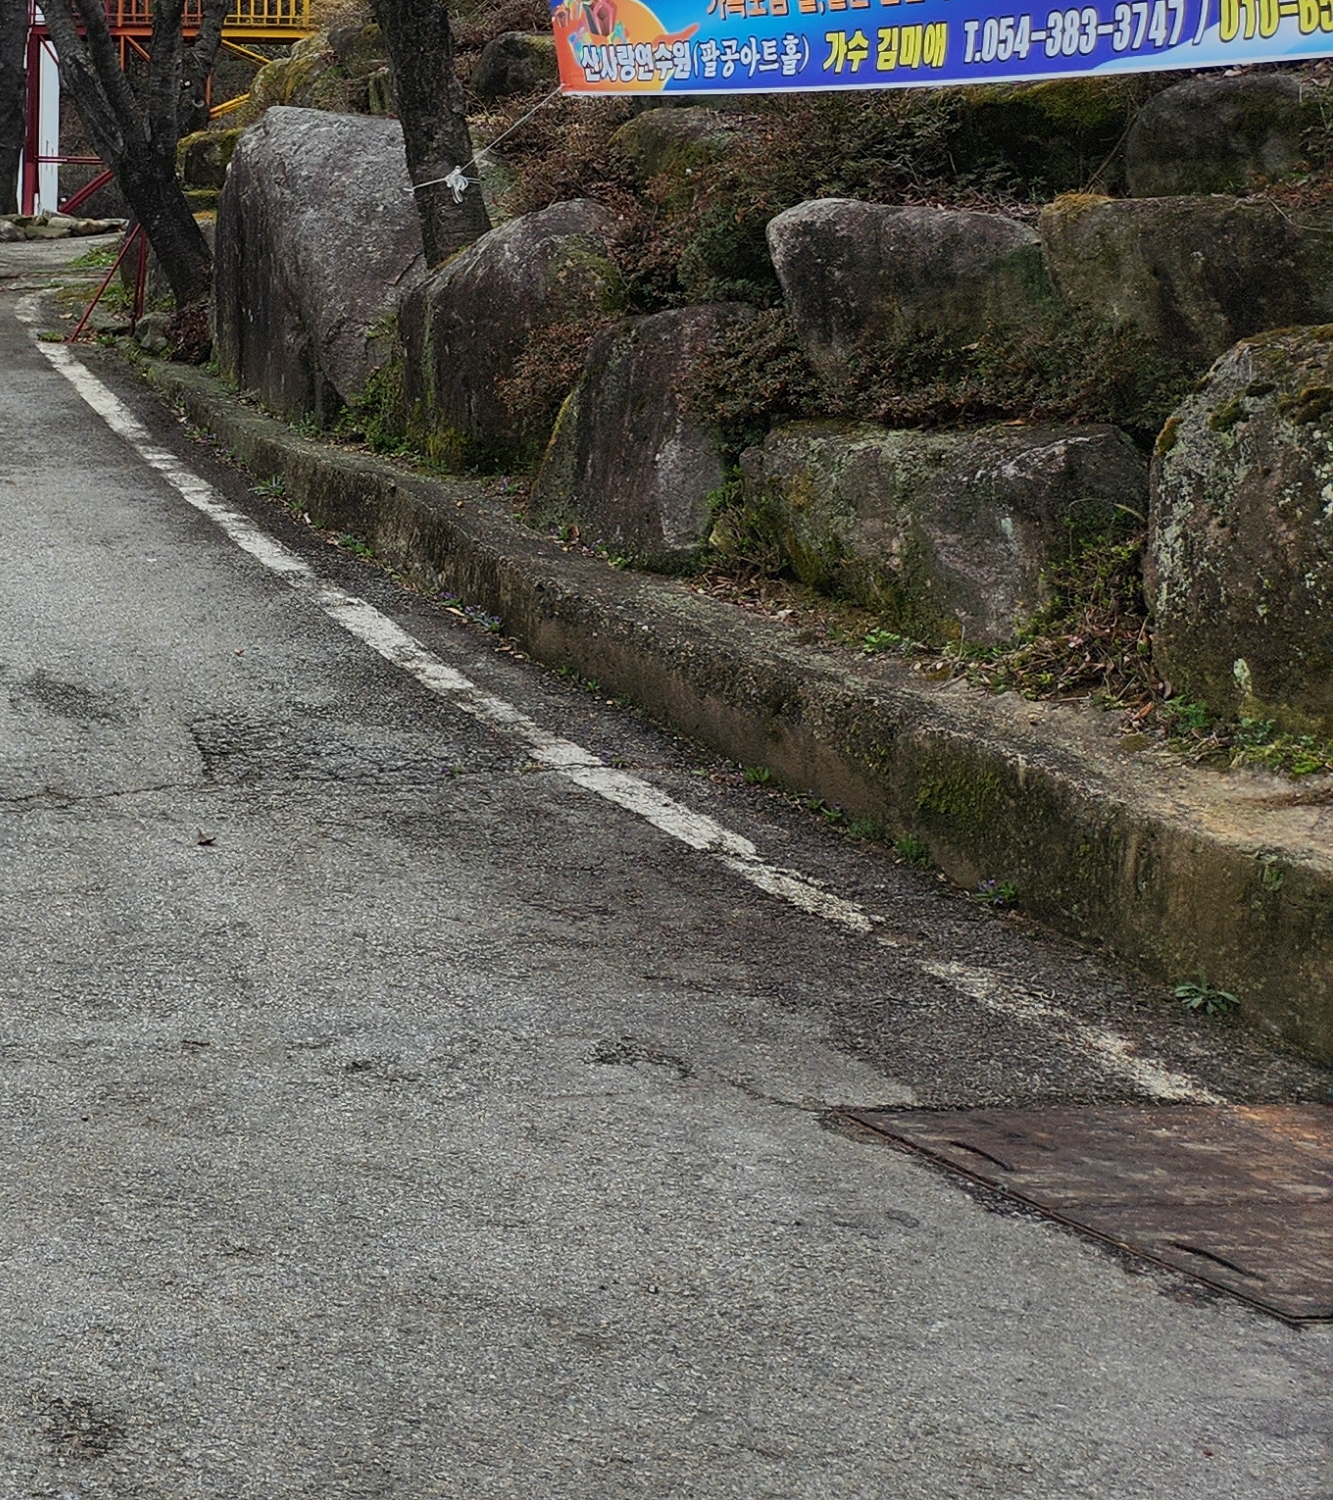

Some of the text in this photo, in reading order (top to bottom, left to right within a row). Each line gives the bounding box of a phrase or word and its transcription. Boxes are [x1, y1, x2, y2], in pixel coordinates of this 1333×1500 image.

[581, 33, 810, 83] 산사랑연수원(팔공아트홀)
[823, 28, 869, 73] 가수
[875, 20, 949, 73] 김미애
